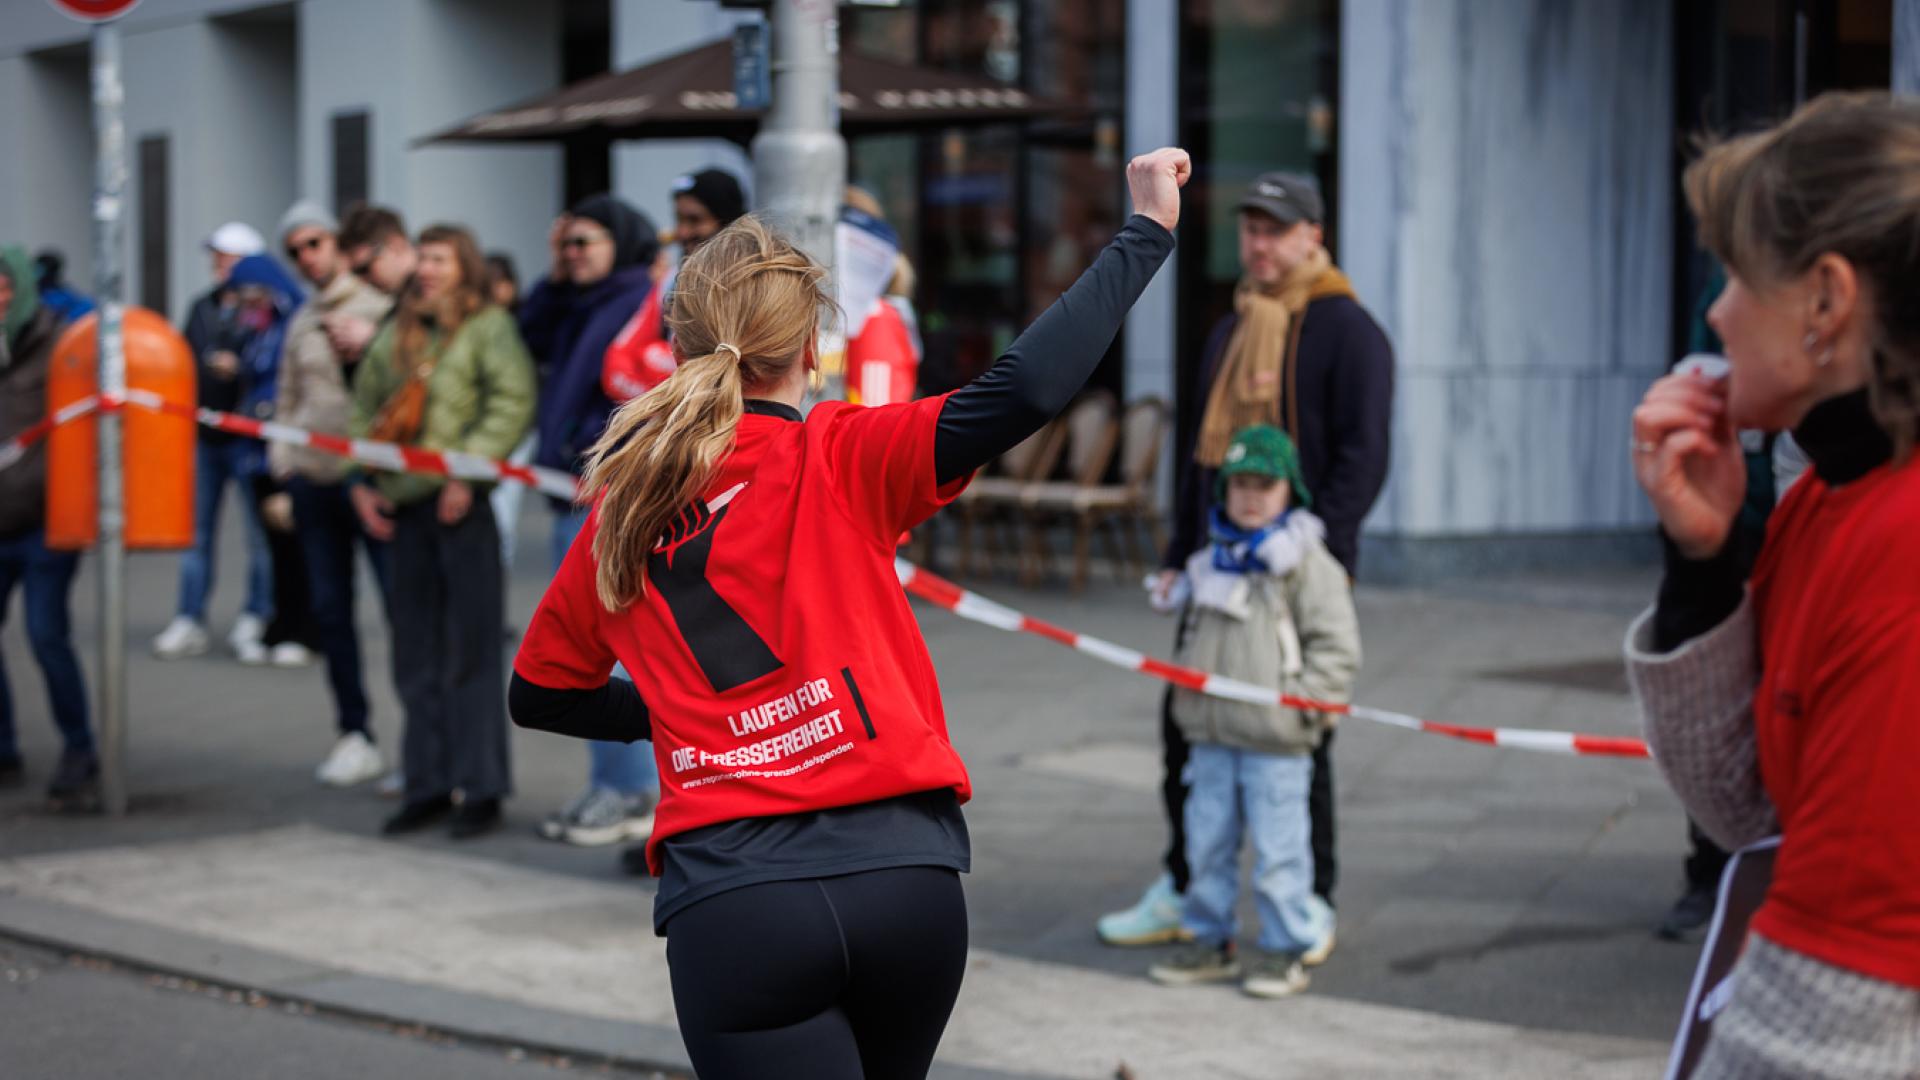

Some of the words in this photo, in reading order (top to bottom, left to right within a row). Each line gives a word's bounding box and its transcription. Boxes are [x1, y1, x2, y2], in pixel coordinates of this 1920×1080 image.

[728, 692, 798, 737] LAUFEN
[796, 677, 833, 711] FÜR
[671, 747, 698, 773] DIE
[699, 709, 844, 767] PRESSEFREIHEIT
[681, 741, 854, 790] www.repor-ohne-grenzen.de/spenden
